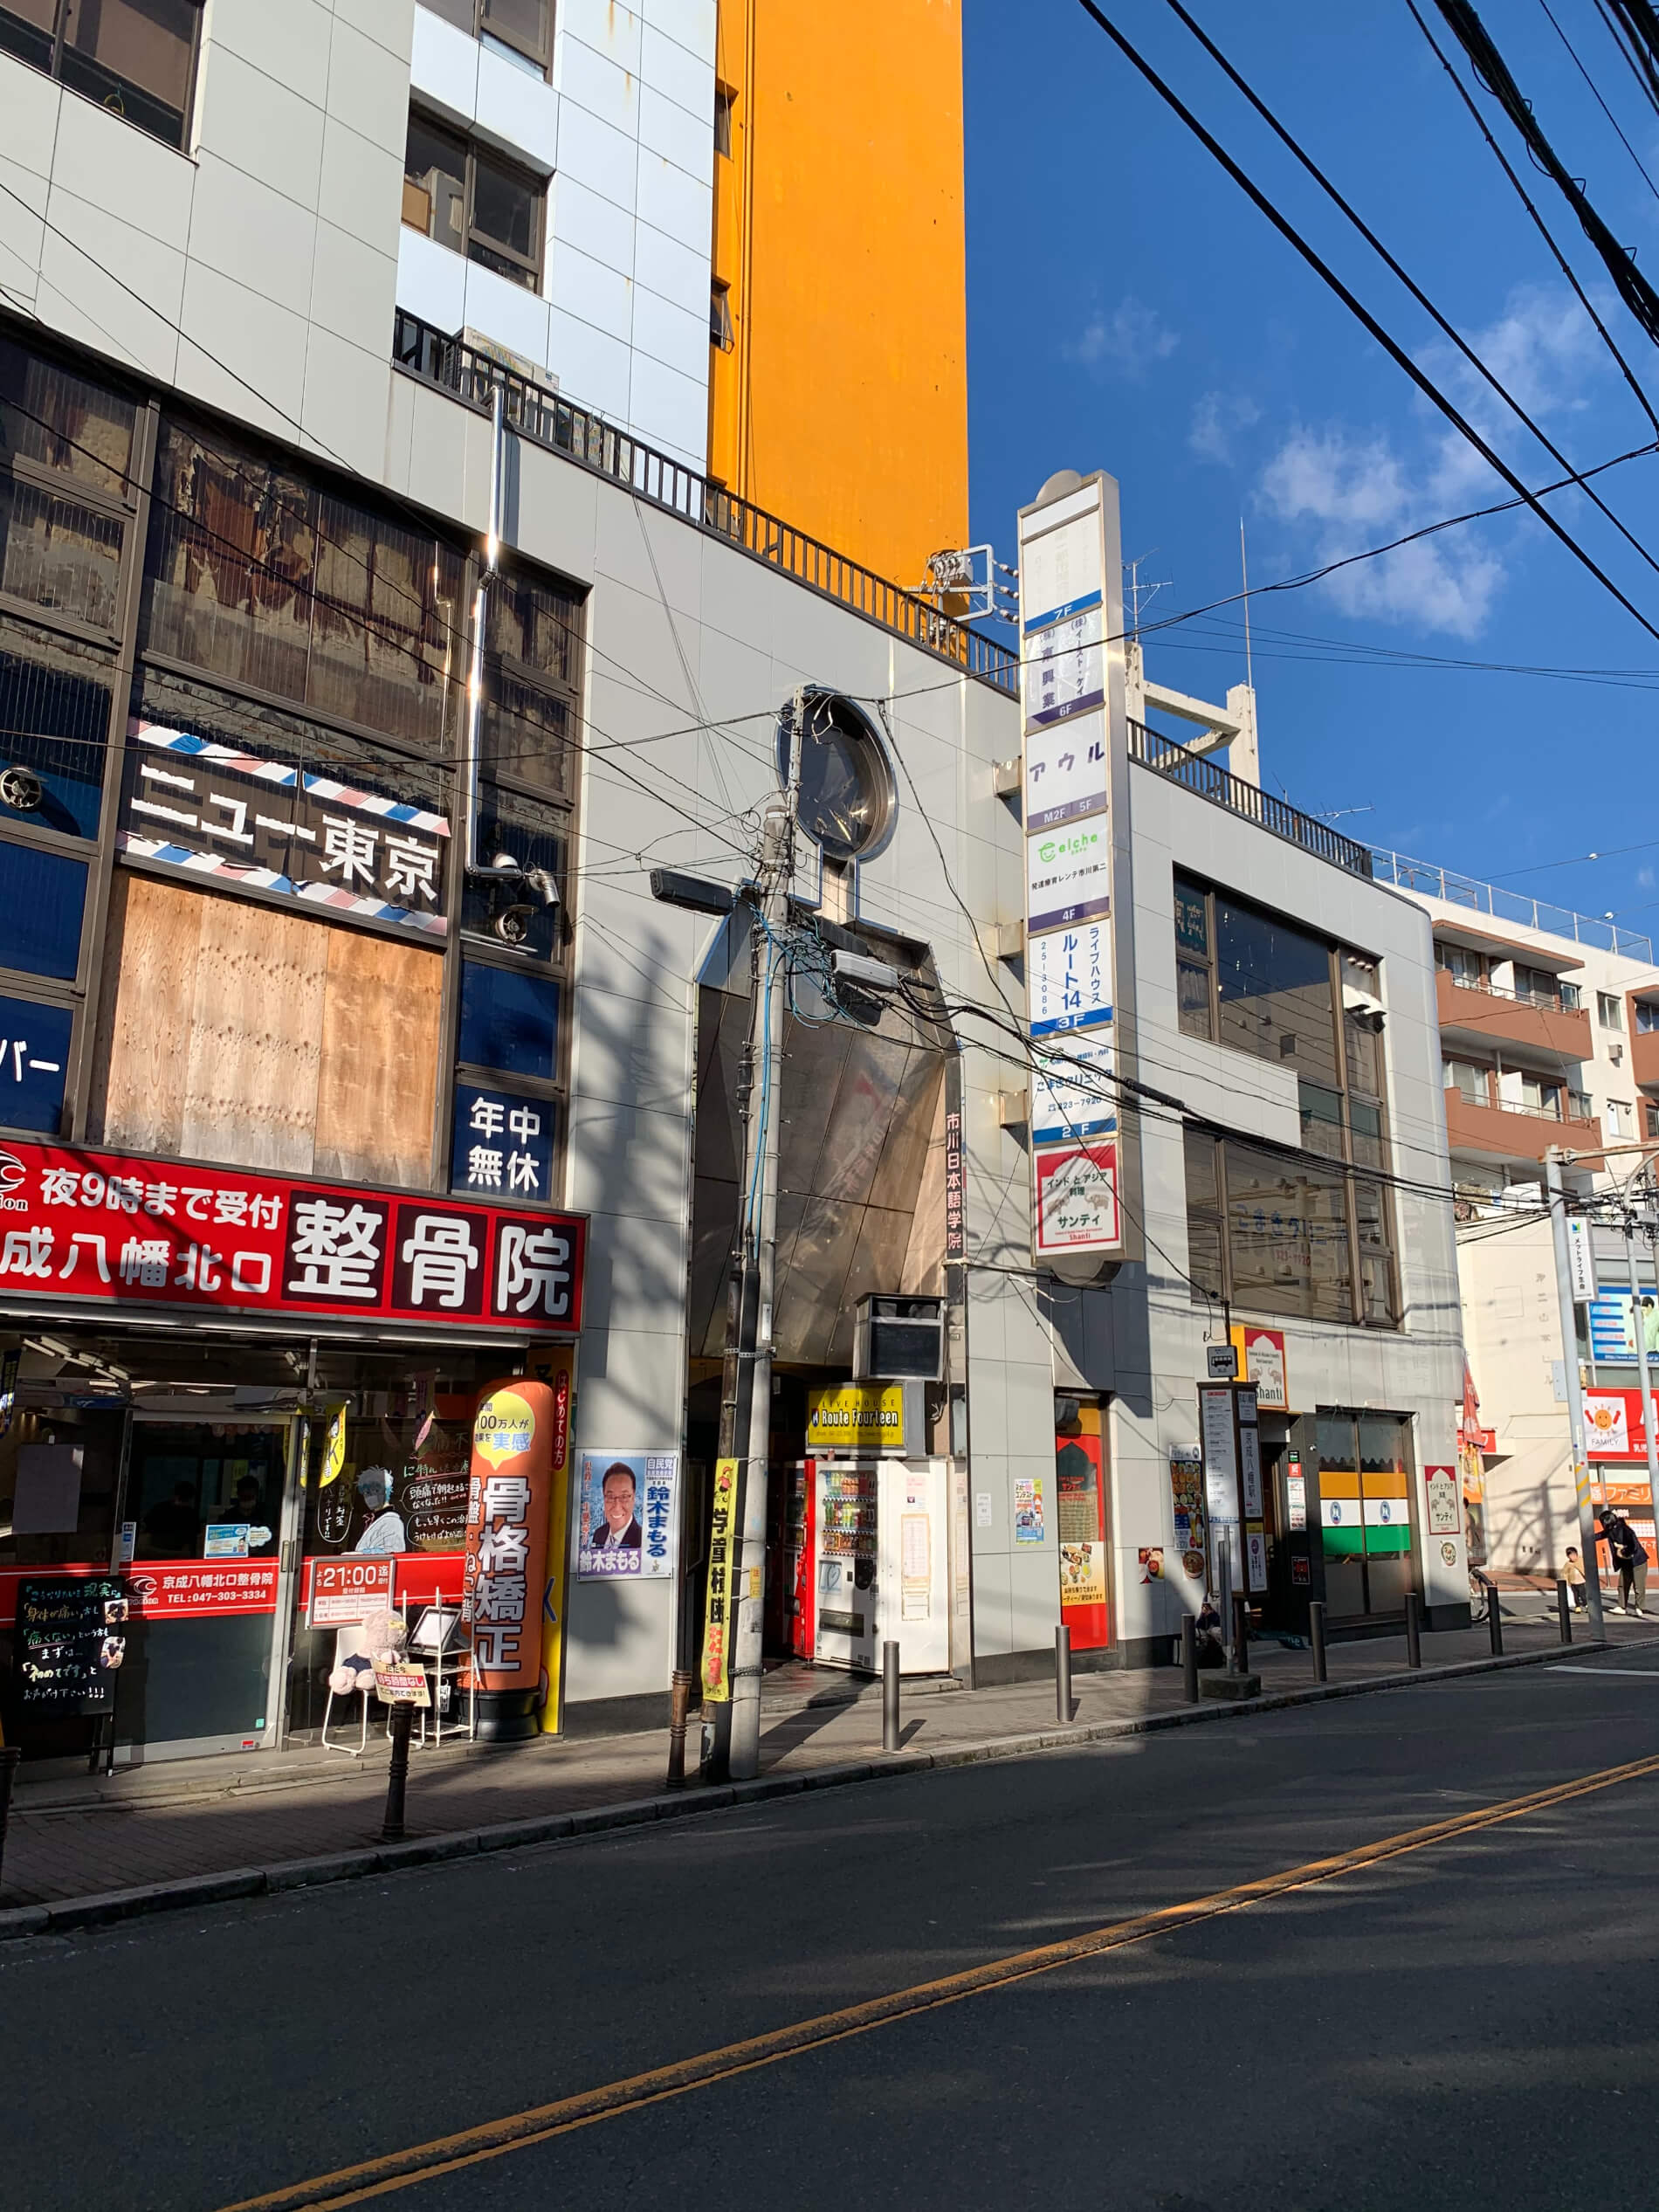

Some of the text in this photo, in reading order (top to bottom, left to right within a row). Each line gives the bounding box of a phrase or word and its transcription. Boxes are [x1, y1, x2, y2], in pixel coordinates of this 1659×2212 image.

[1054, 604, 1073, 621] 7F
[1059, 704, 1073, 717] 6F
[1029, 741, 1105, 782] アウル
[1043, 798, 1092, 823] M2F 5F
[129, 762, 440, 901] ニュー東京
[1062, 908, 1076, 921] 4F
[1061, 934, 1082, 1011] ルート14
[0, 1038, 60, 1082] バー
[469, 1096, 540, 1145] 年中
[468, 1145, 540, 1191] 無休
[946, 1113, 961, 1250] 市川日本語学院
[39, 1167, 284, 1230] 夜9時まで受付
[1057, 1213, 1100, 1229] サンティ
[288, 1199, 570, 1316] 整骨院
[1574, 1238, 1586, 1290] メットライフ生命
[822, 1398, 896, 1408] LIVE HOUSE
[556, 1375, 568, 1465] はじめての方
[822, 1408, 850, 1427] Route
[851, 1408, 898, 1427] Fourteen
[492, 1431, 532, 1452] 実感
[1591, 1438, 1620, 1447] FAMILY
[647, 1458, 673, 1470] 自民党
[646, 1485, 671, 1558] 鈴木まもる
[474, 1476, 531, 1670] 骨格矯正
[579, 1549, 640, 1574] 鈴木まもる
[162, 1572, 273, 1589] 京成八幡北口整骨院
[323, 1565, 376, 1588] 21:00
[167, 1590, 266, 1604] TEL:047-303-3334
